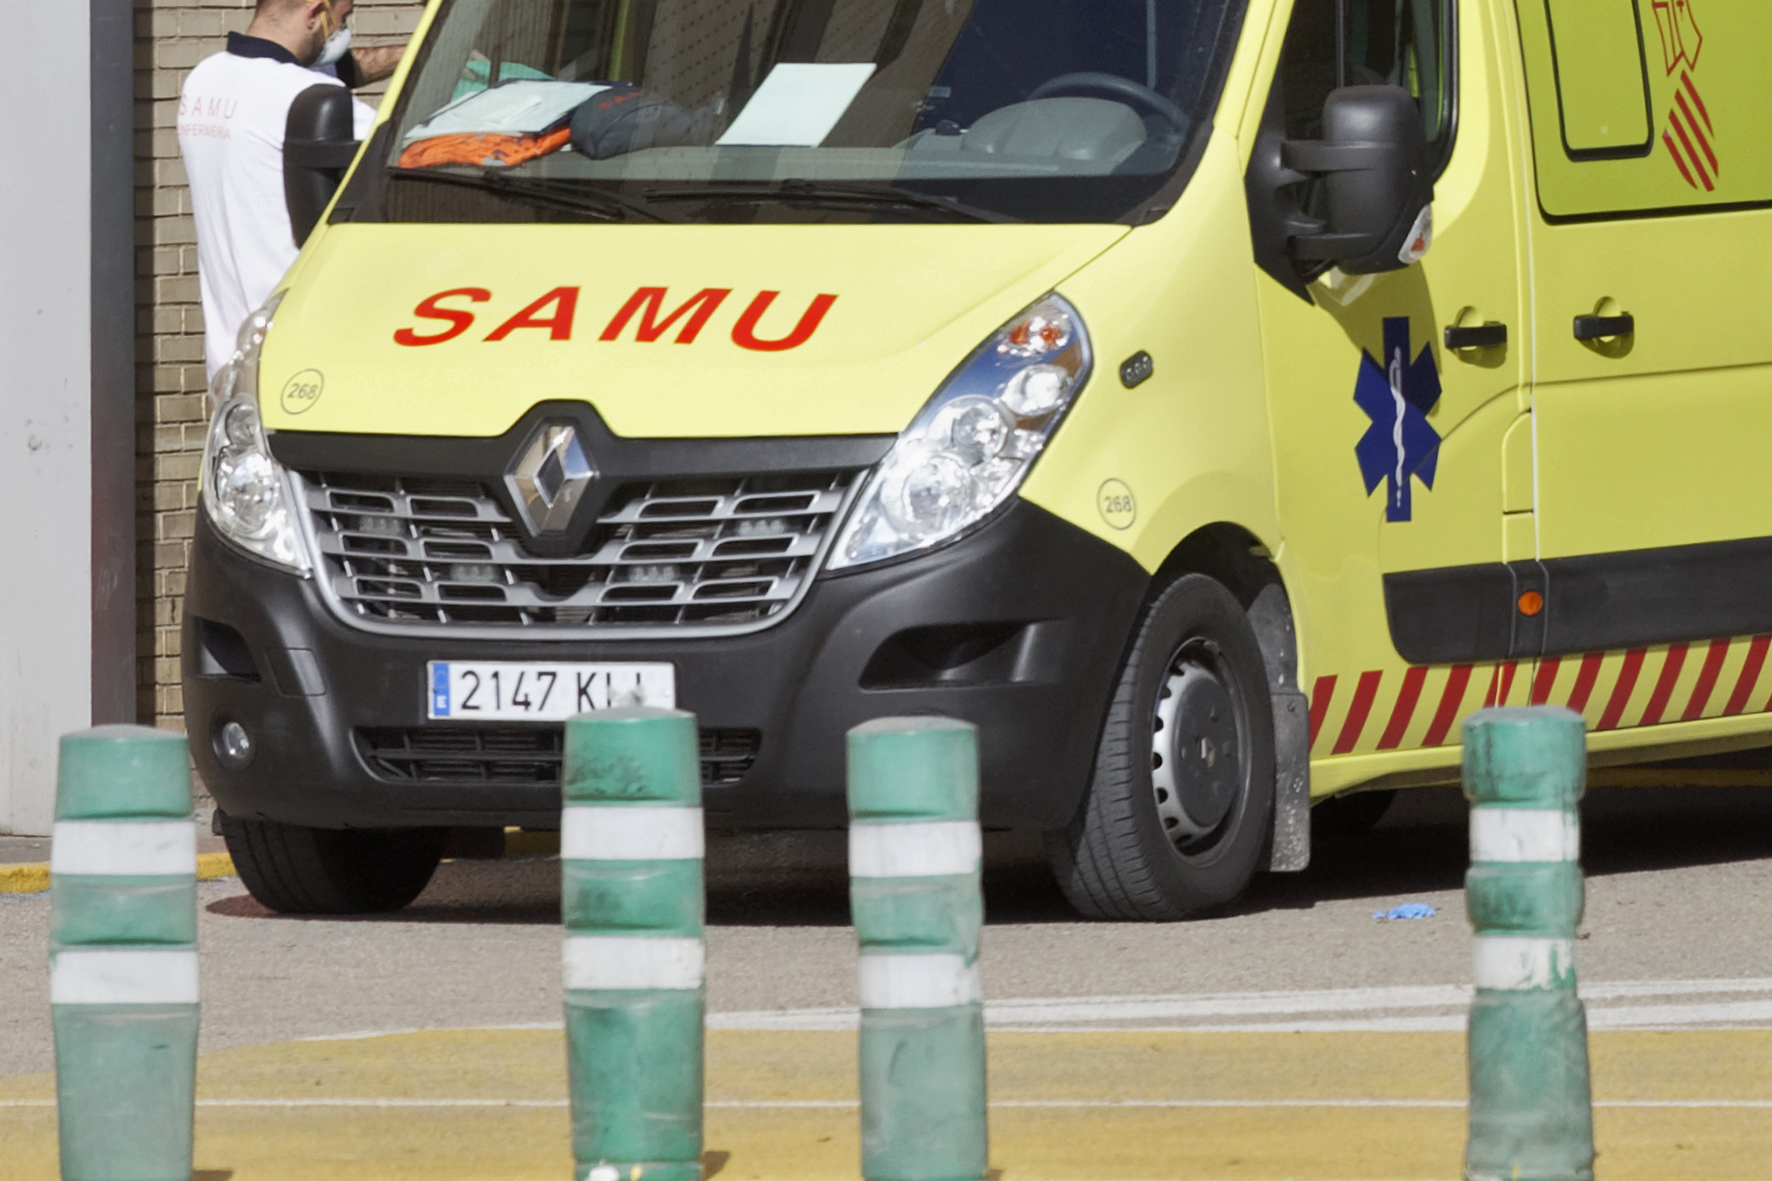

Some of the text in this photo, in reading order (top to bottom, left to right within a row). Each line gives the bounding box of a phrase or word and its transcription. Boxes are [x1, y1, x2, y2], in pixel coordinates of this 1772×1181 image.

[392, 286, 839, 352] SAMU
[287, 382, 318, 400] 268
[1104, 495, 1132, 513] 268
[461, 670, 557, 712] 2147
